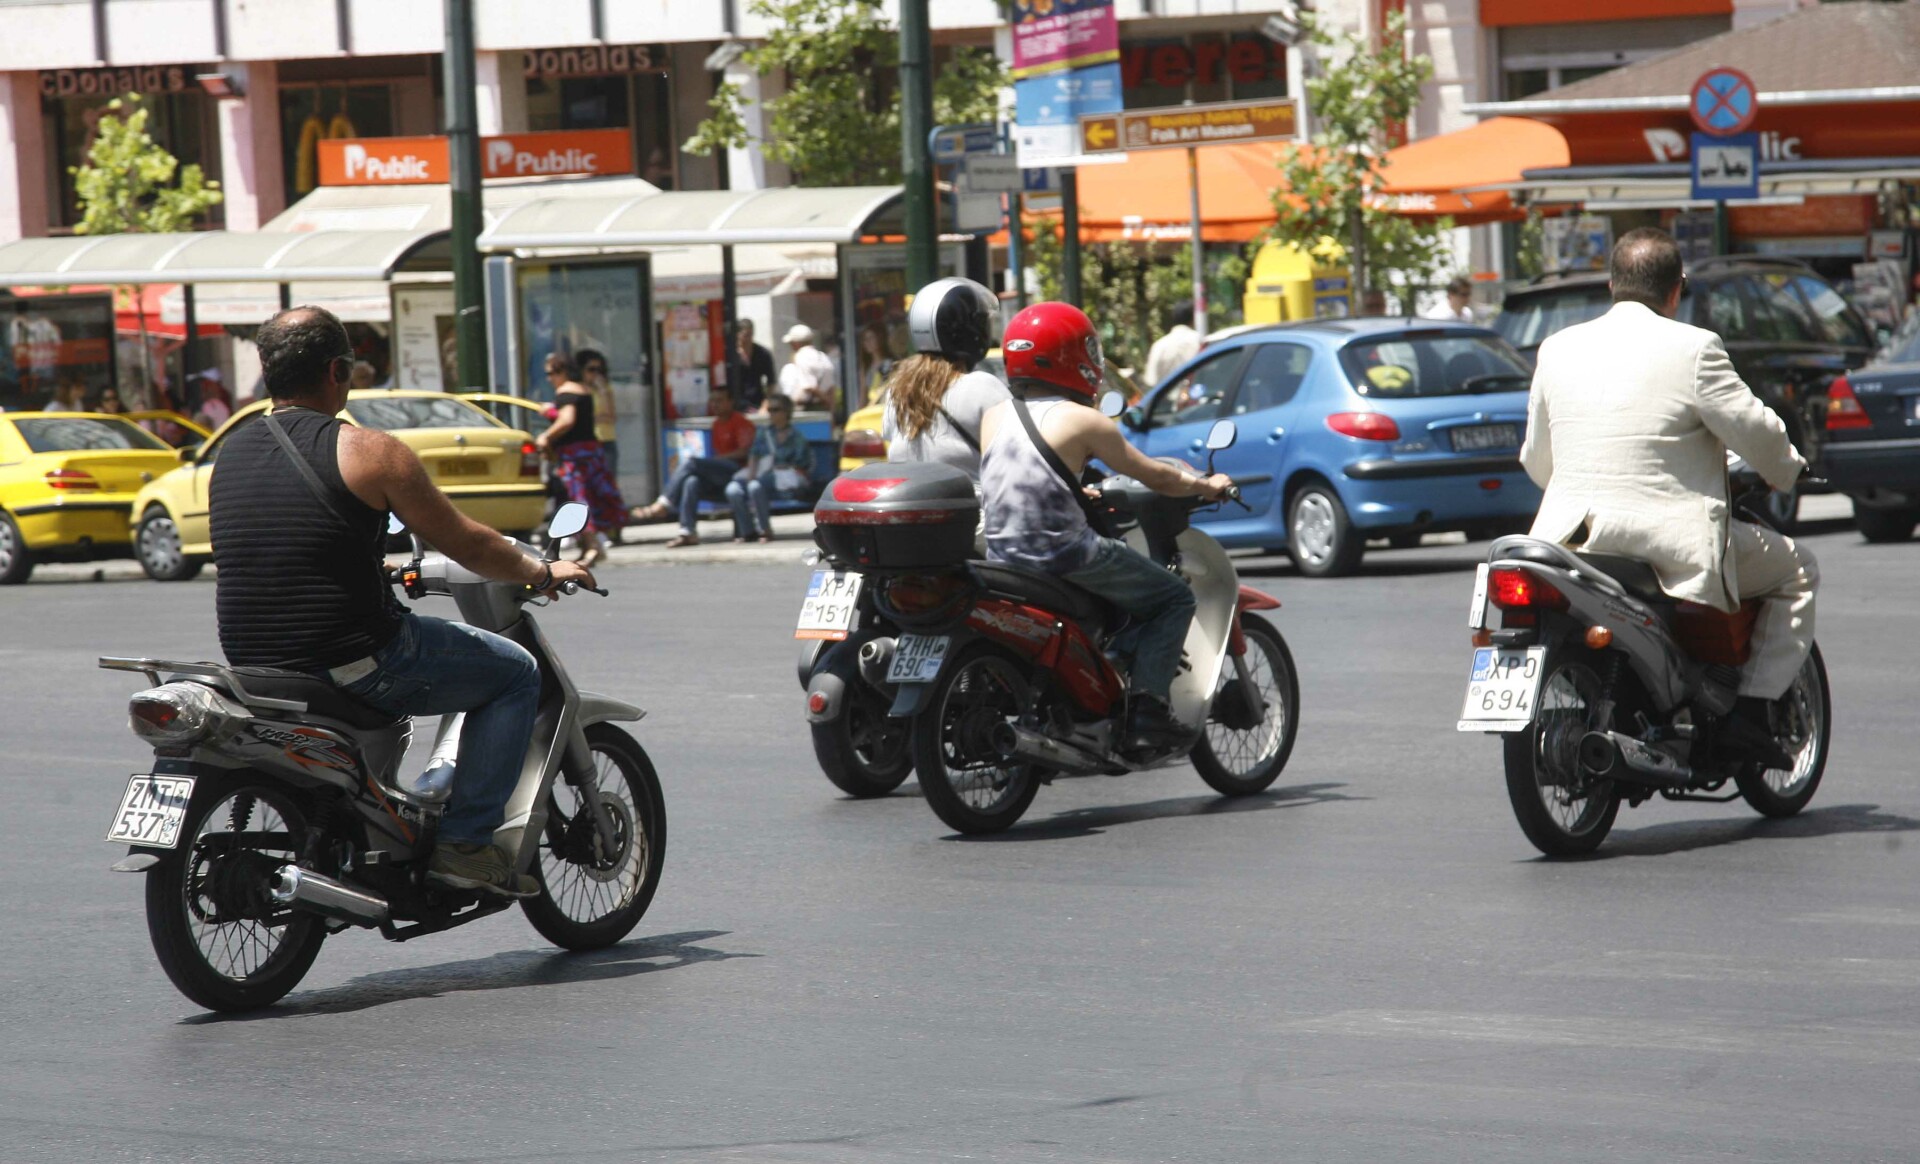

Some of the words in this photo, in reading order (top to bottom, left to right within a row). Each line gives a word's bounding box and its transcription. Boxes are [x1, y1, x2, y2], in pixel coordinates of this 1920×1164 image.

[1151, 127, 1178, 143] Folk
[1180, 126, 1199, 141] Art
[1200, 123, 1254, 139] Museum
[366, 155, 429, 179] Public
[515, 149, 597, 174] Public
[820, 578, 856, 597] XPA
[815, 604, 850, 624] 151
[899, 636, 937, 656] ZHH
[1481, 689, 1529, 711] 694
[127, 782, 172, 810] ZMT
[112, 811, 164, 839] 537
